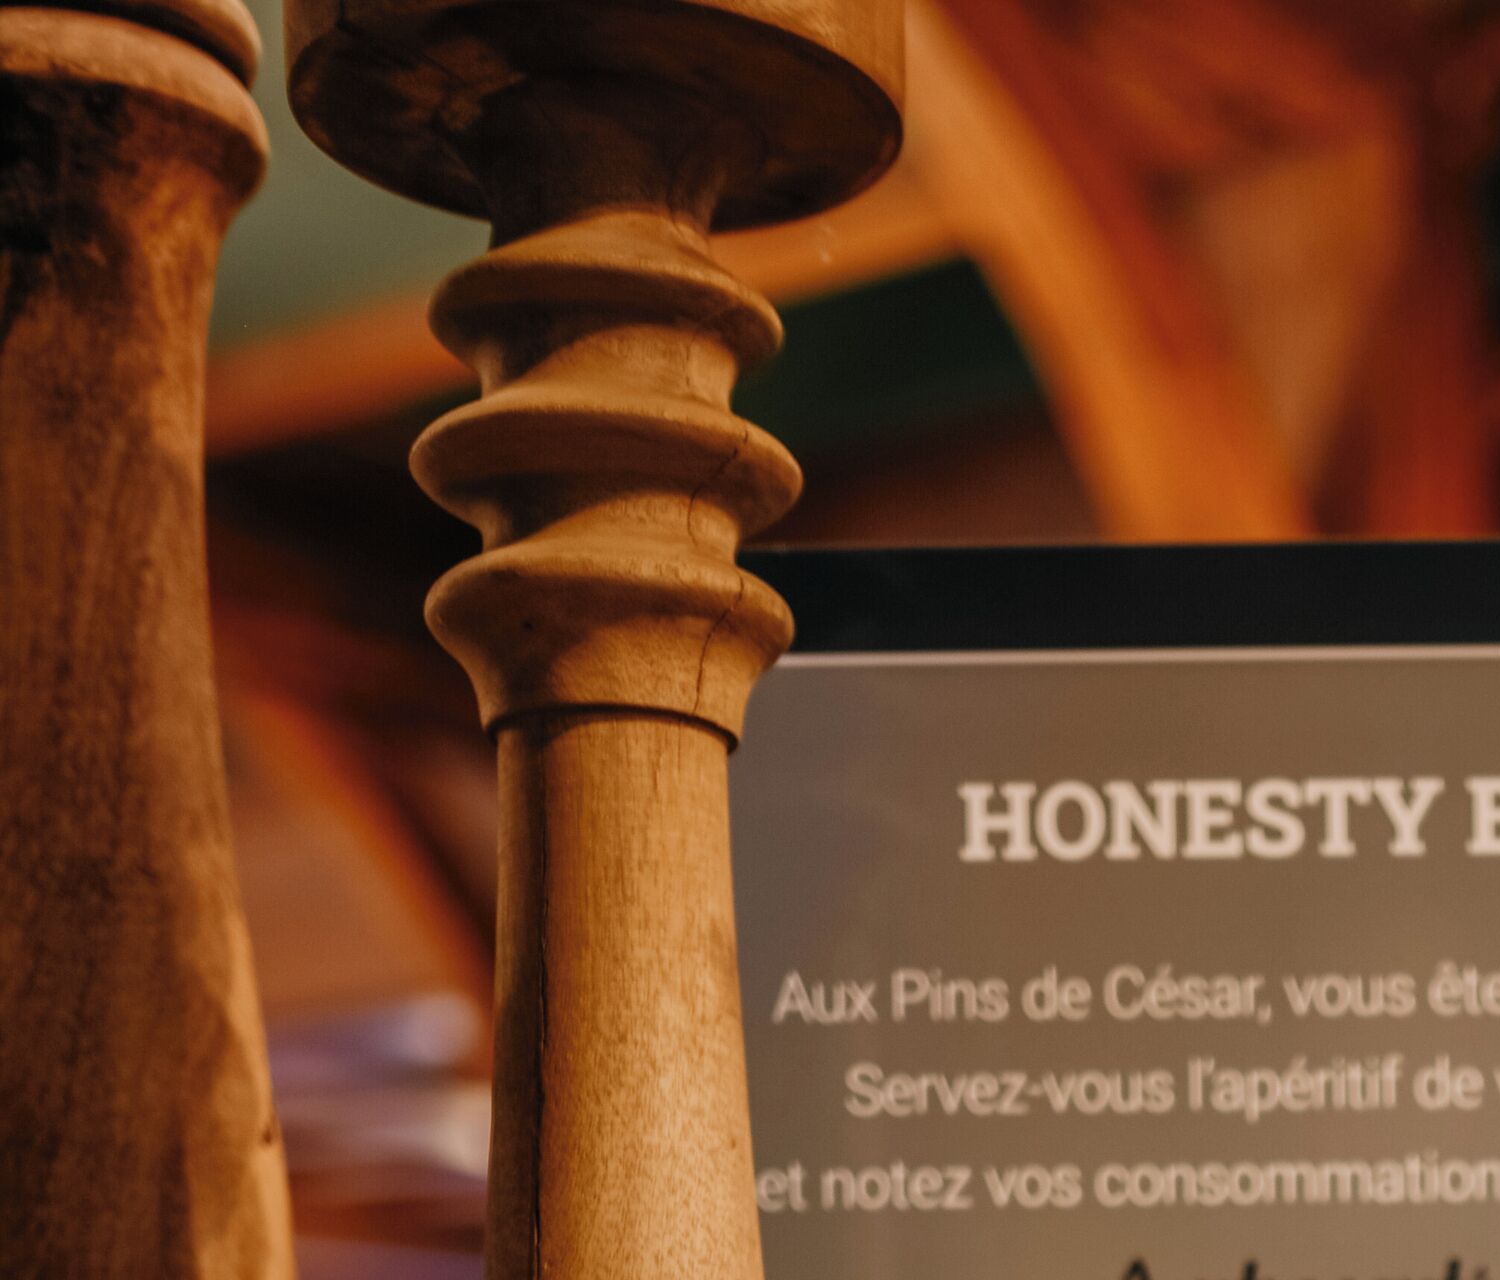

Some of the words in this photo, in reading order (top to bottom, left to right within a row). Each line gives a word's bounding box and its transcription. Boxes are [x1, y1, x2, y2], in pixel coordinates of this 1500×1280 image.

[958, 777, 1444, 861] HONESTY
[773, 970, 877, 1024] Aux
[891, 968, 1010, 1022] Pins
[1021, 964, 1092, 1022] de
[1104, 962, 1272, 1026] César,
[1283, 972, 1416, 1018] vous
[844, 1061, 1175, 1118] Servez-vous
[1188, 1053, 1404, 1124] l'apéritif
[1412, 1053, 1484, 1110] de
[756, 1161, 806, 1212] et
[820, 1160, 973, 1211] notez
[983, 1164, 1083, 1210] vos
